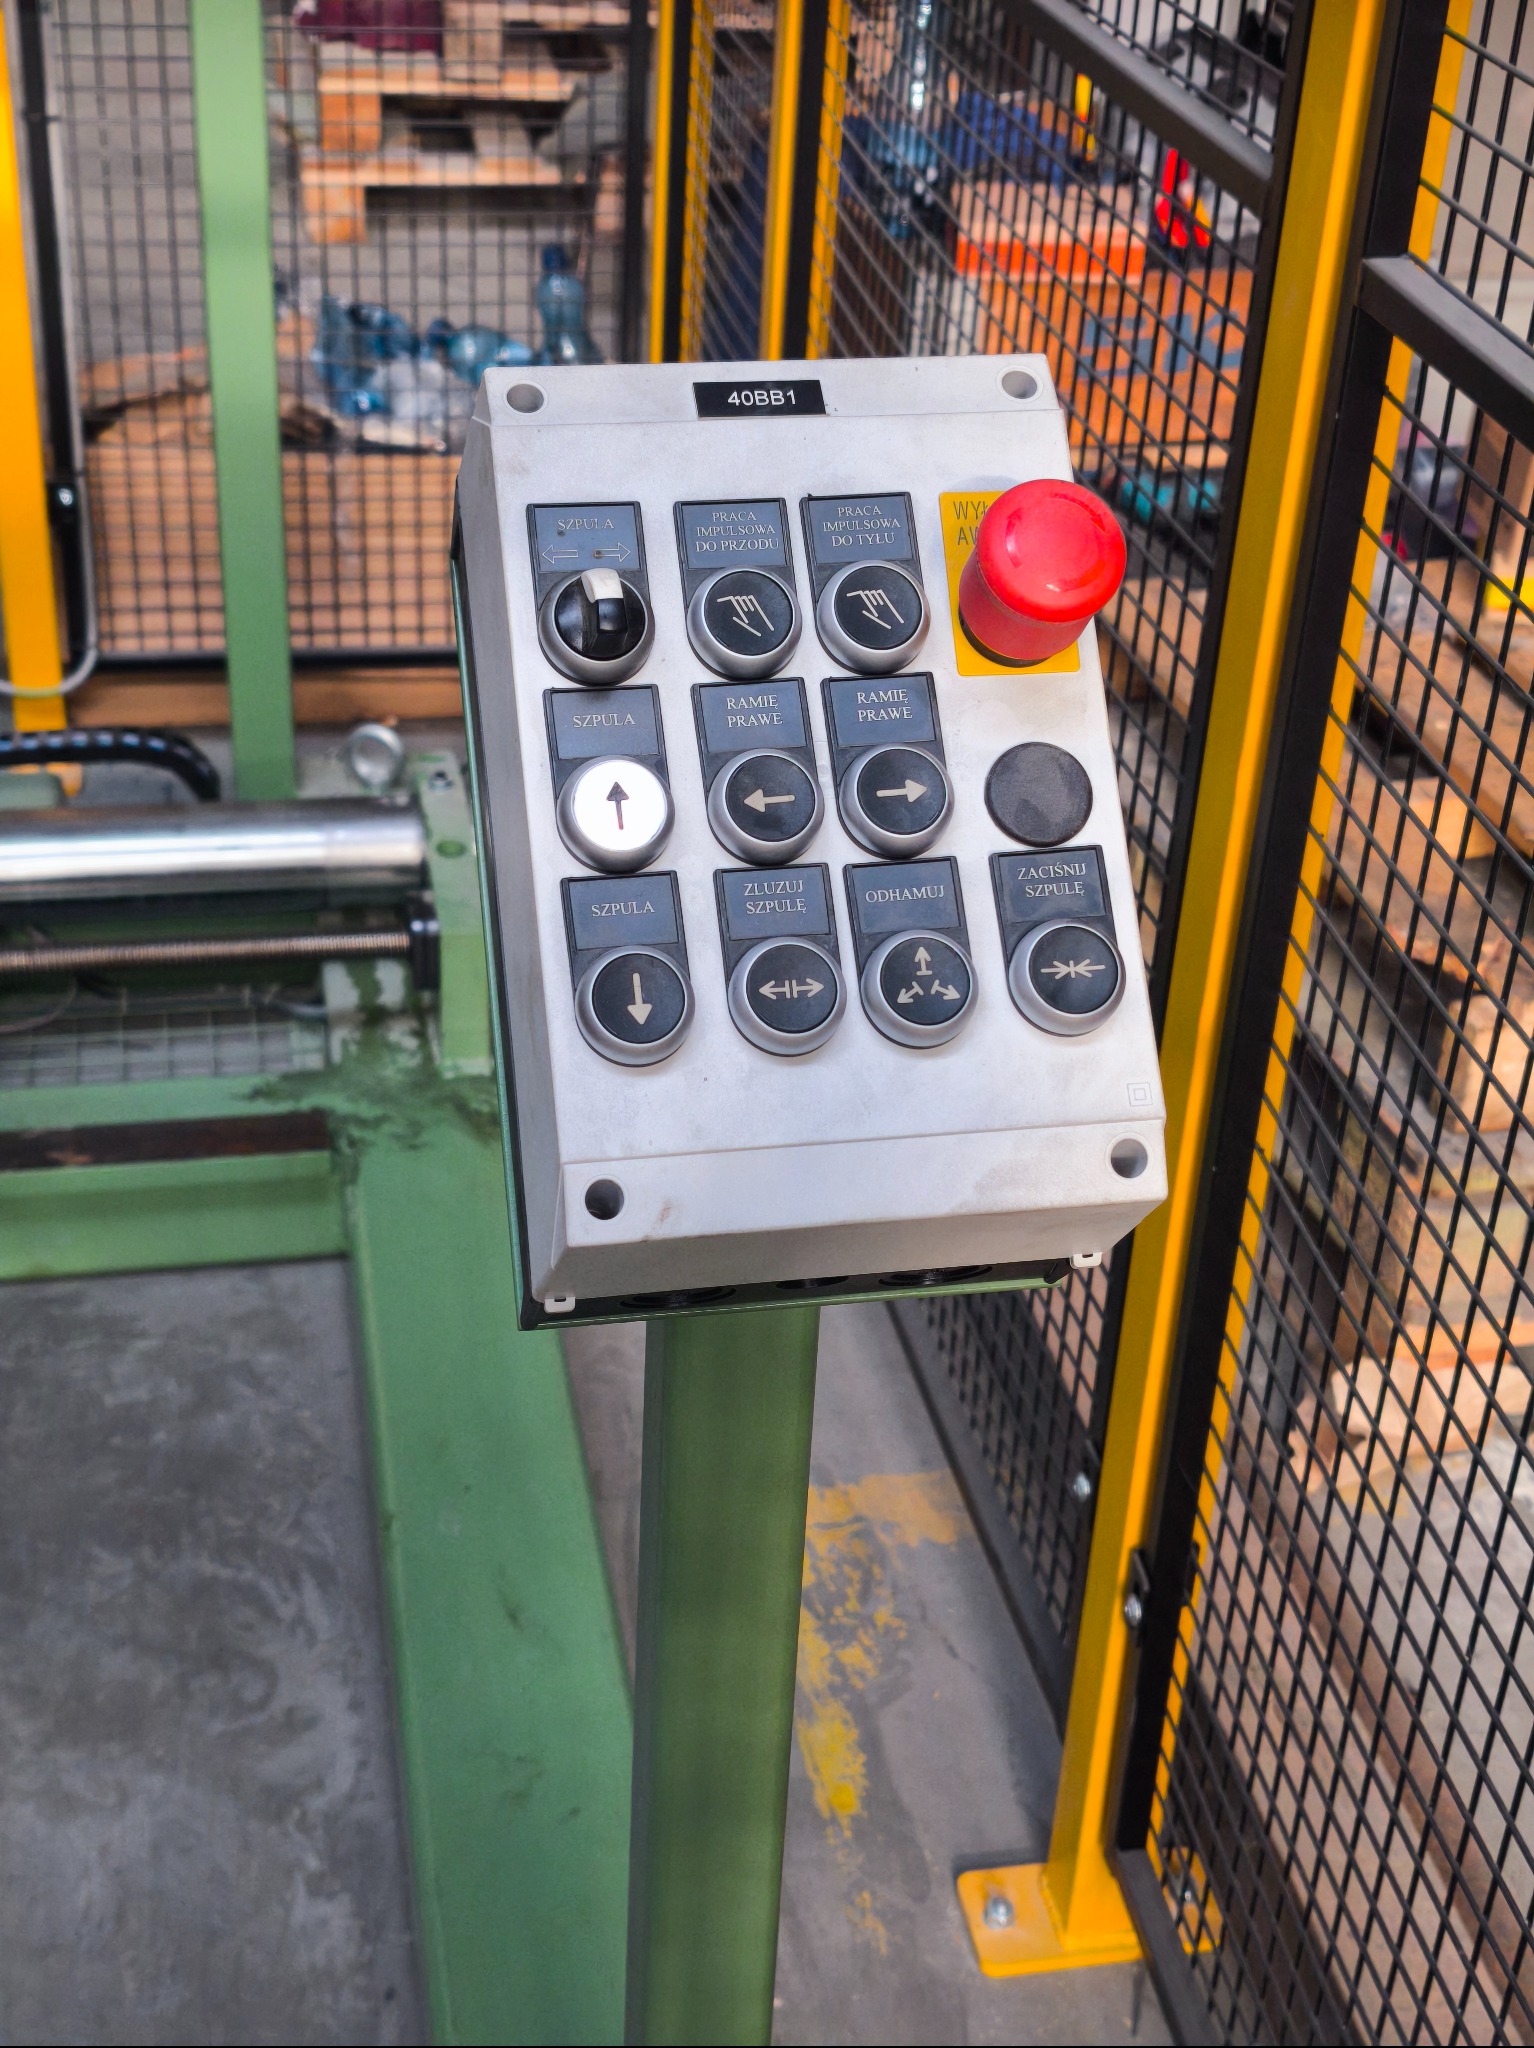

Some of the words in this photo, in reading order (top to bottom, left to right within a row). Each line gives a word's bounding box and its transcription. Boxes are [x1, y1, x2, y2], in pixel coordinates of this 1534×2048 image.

[727, 389, 796, 407] 40BB1
[712, 511, 757, 522] PRACA
[837, 505, 882, 517] PRACA
[557, 518, 615, 530] SZPULA
[697, 524, 776, 537] IMPULSOWA
[823, 518, 901, 532] IMPULSOWA
[696, 541, 717, 552] DO
[721, 538, 779, 552] PRZODU
[831, 535, 853, 547] DO
[856, 532, 895, 545] TYŁU
[726, 694, 779, 710] RAMIĘ
[856, 689, 909, 704] RAMIĘ
[573, 713, 635, 728] SZPULA
[727, 712, 783, 728] PRAWE
[857, 706, 913, 722] PRAWE
[1017, 862, 1087, 880] ZACIŚNIJ
[744, 880, 804, 896] ZLUZUJ
[865, 884, 945, 903] ODHAMUJ
[1025, 881, 1085, 898] SZPULĘ
[591, 901, 655, 917] SZPULA
[746, 898, 807, 914] SZPULĘ
